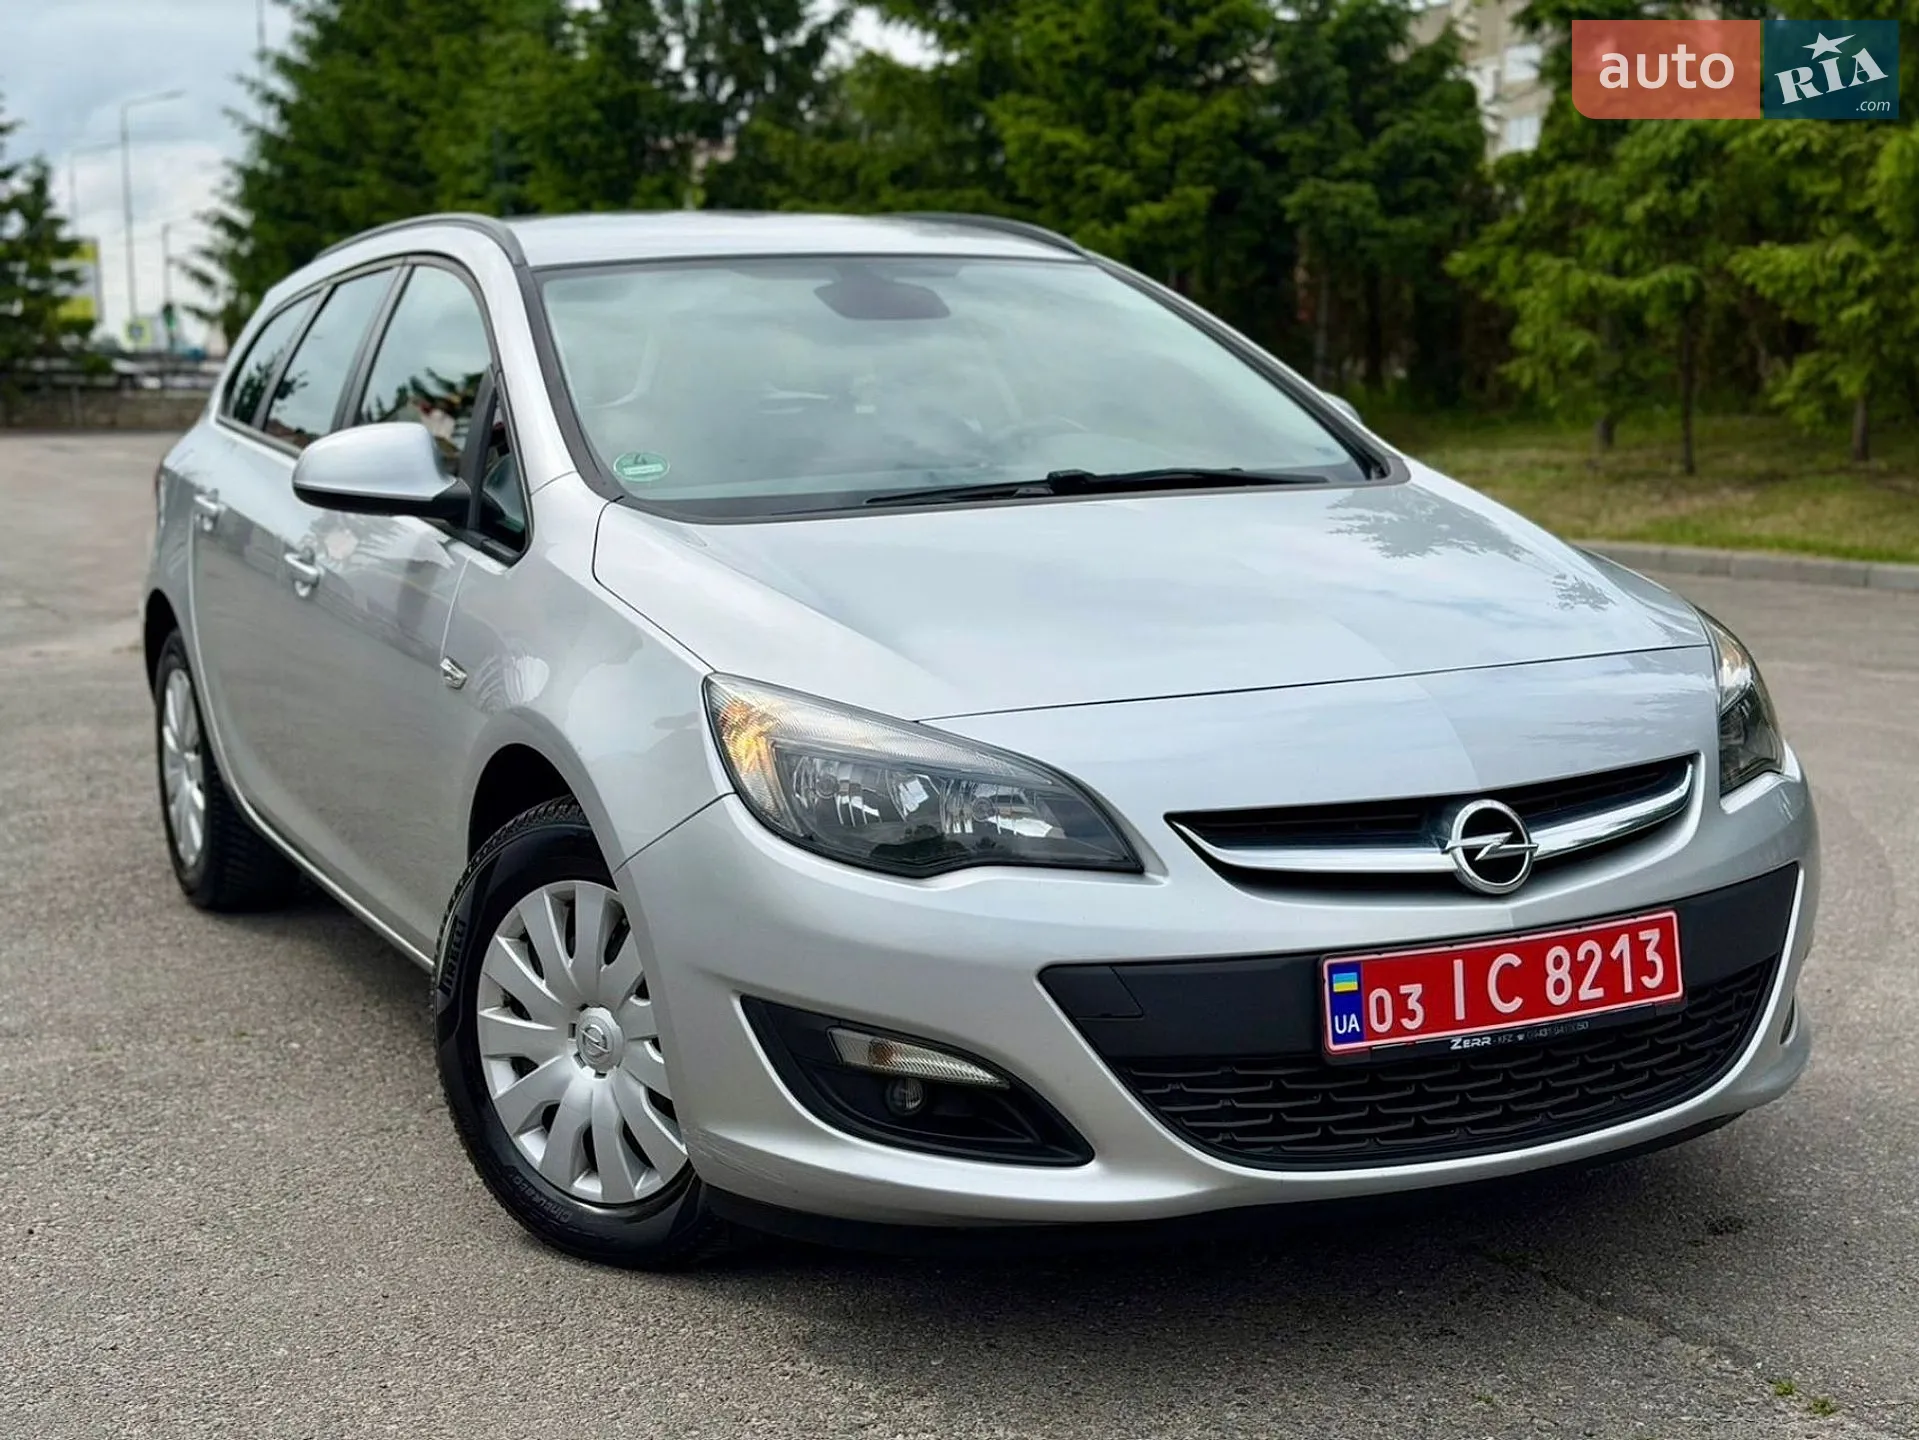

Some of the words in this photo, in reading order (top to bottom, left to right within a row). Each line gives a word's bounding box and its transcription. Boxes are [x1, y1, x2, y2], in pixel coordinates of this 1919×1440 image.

[1367, 983, 1424, 1034] 03
[1544, 927, 1665, 1006] 8213
[1334, 1014, 1360, 1035] UA
[1450, 1036, 1492, 1050] ZERR
